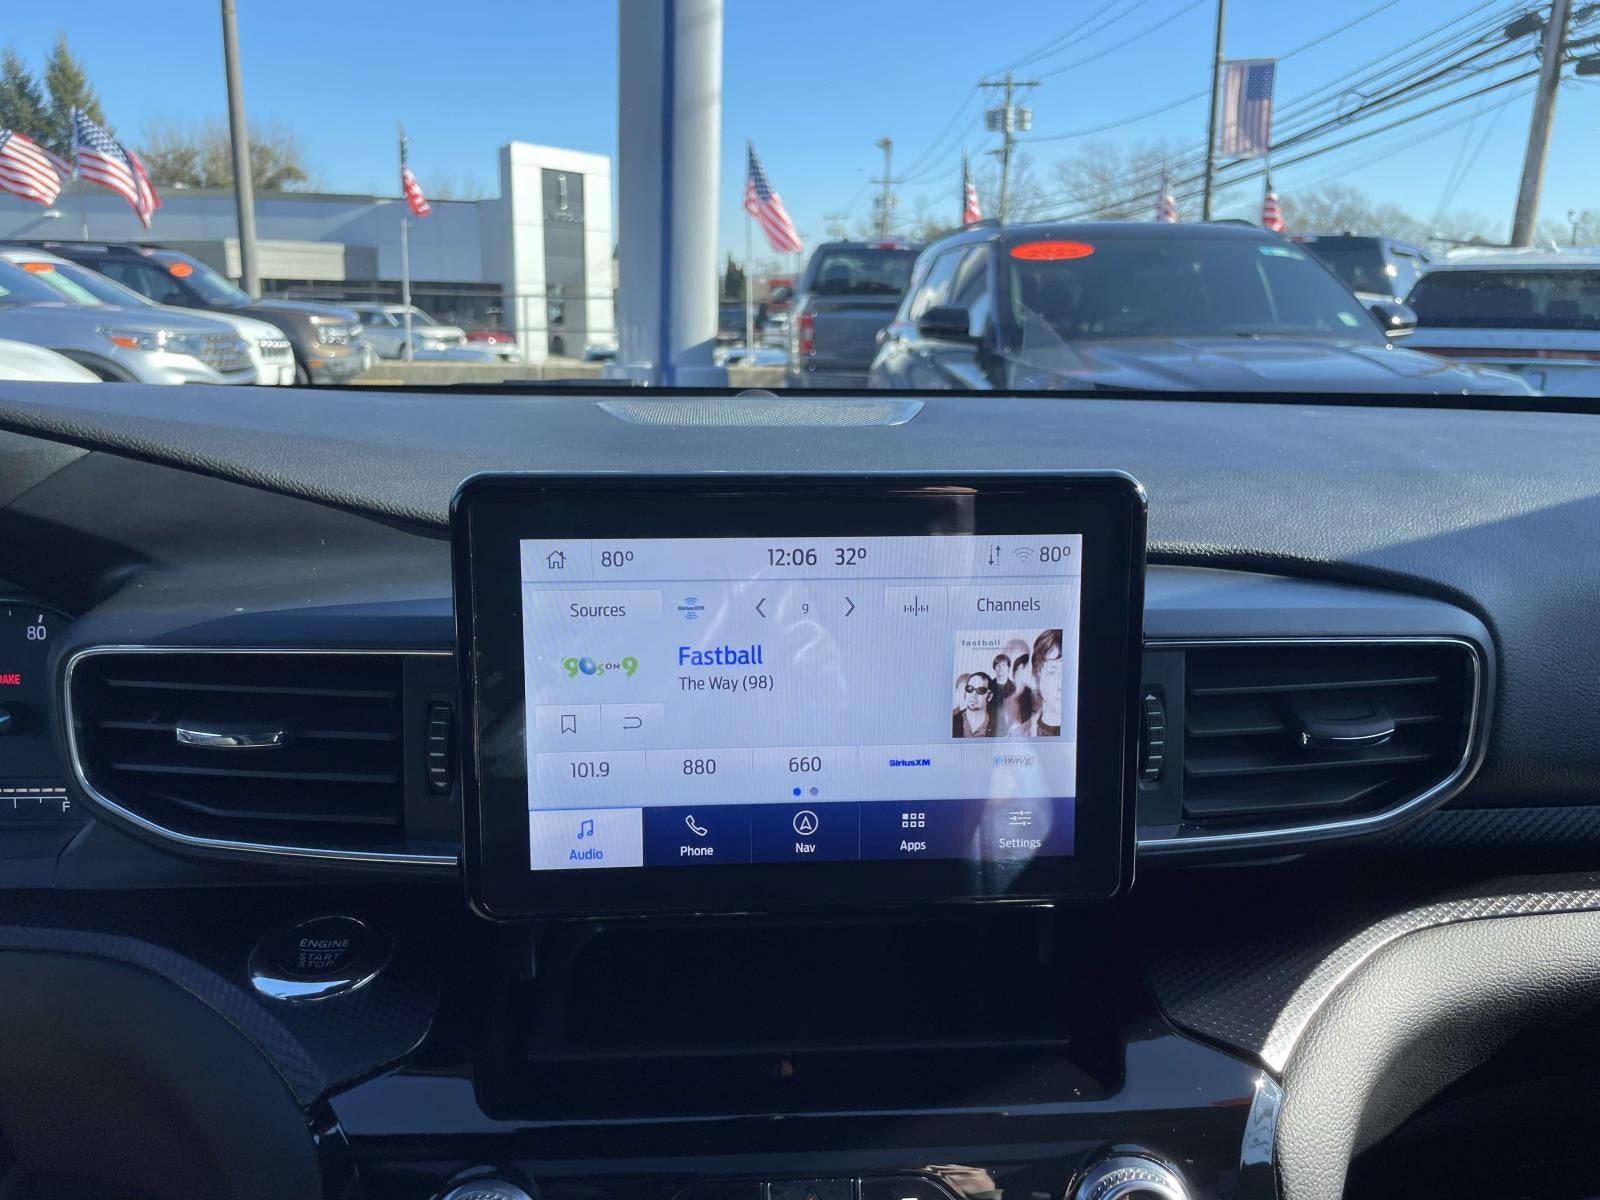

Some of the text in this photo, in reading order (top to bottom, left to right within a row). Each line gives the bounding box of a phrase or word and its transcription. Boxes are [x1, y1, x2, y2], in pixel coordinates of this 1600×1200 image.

[767, 548, 817, 566] 12:06
[570, 603, 626, 617] Sources
[977, 597, 1041, 612] Channels
[27, 625, 46, 640] 80
[961, 639, 1001, 647] fastball
[678, 645, 763, 666] Fastball
[622, 656, 638, 677] 9
[679, 674, 774, 692] The Way (98)
[683, 760, 716, 775] 880
[789, 756, 822, 772] 660
[889, 758, 931, 767] SiriusXM
[571, 762, 610, 778] 101.9
[62, 801, 70, 812] F
[795, 842, 816, 853] Nav
[900, 840, 926, 852] Apps
[999, 837, 1042, 849] Settings
[569, 849, 603, 861] Audio
[680, 846, 714, 857] Phone
[299, 938, 351, 948] ENGINE
